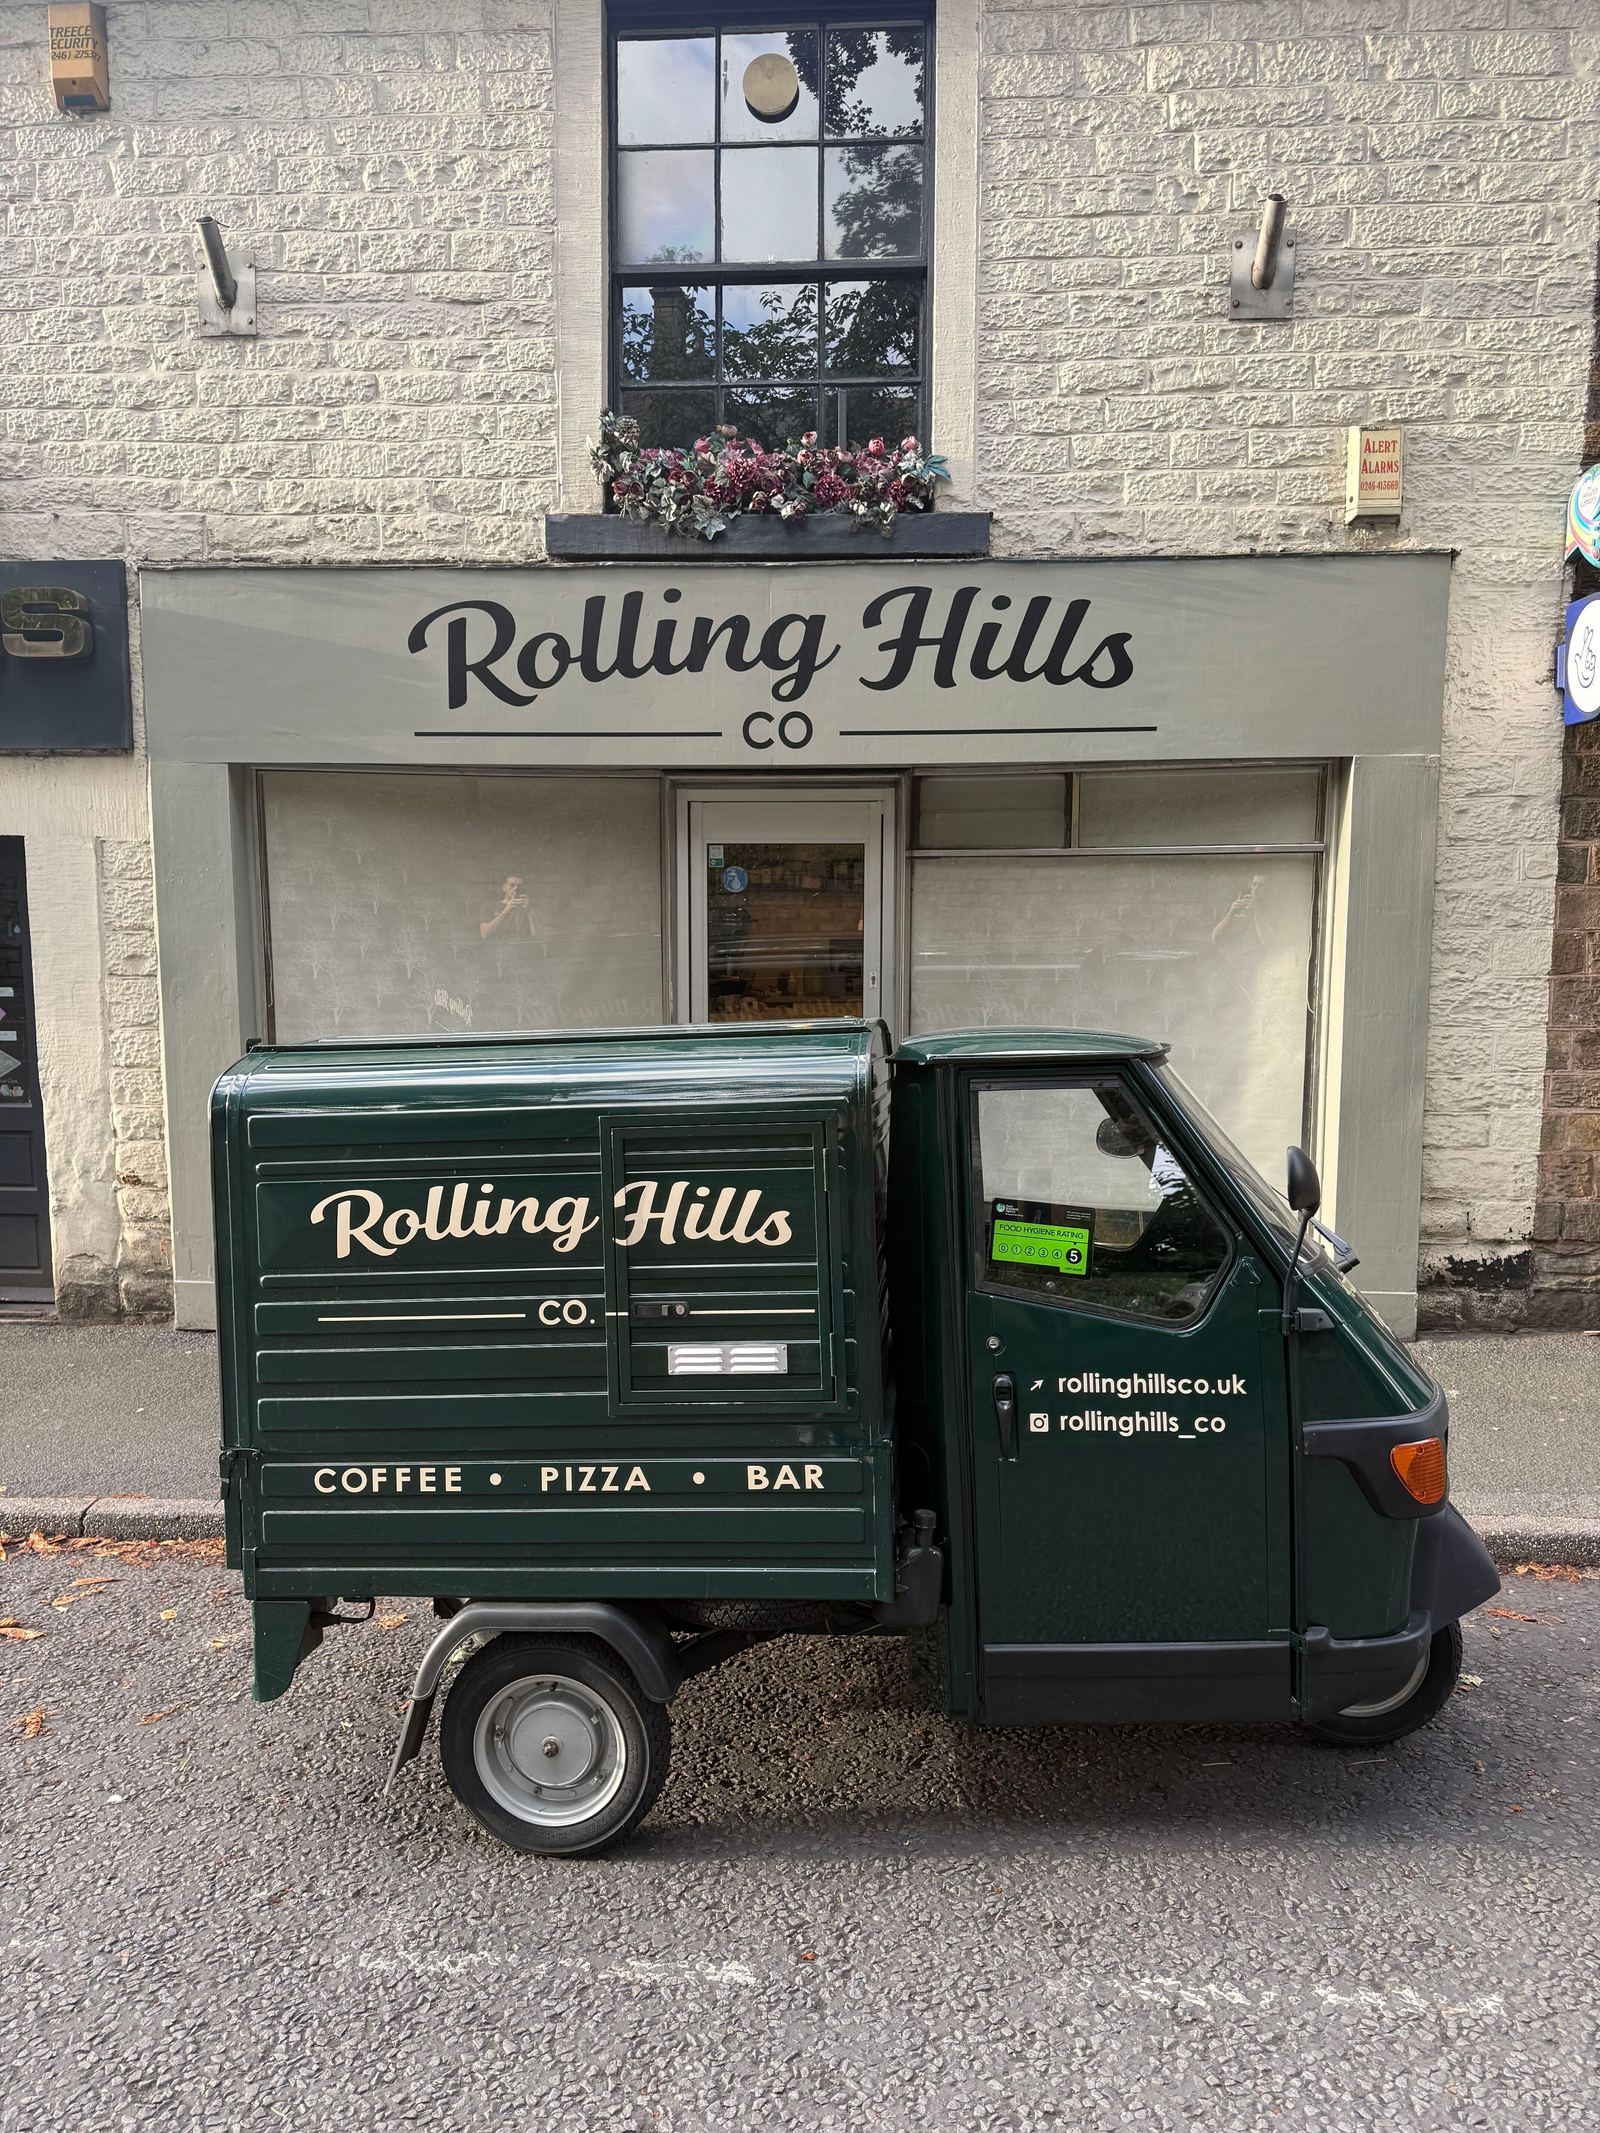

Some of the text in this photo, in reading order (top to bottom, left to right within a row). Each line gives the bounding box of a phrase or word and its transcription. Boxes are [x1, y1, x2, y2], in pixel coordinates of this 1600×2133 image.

[1363, 437, 1398, 453] ALERT
[1361, 458, 1399, 474] ALARMS
[408, 586, 1133, 709] Rolling Hills
[742, 711, 813, 749] CO
[311, 1180, 792, 1258] Rolling Hills
[999, 1224, 1084, 1239] FOOD HYGIENE RATING
[1069, 1250, 1079, 1263] 5
[537, 1300, 595, 1325] CO.
[1058, 1372, 1247, 1399] rollinghillsco.uk
[1060, 1410, 1226, 1439] rollinghills_co
[314, 1464, 825, 1493] COFFEE PIZZA BAR
